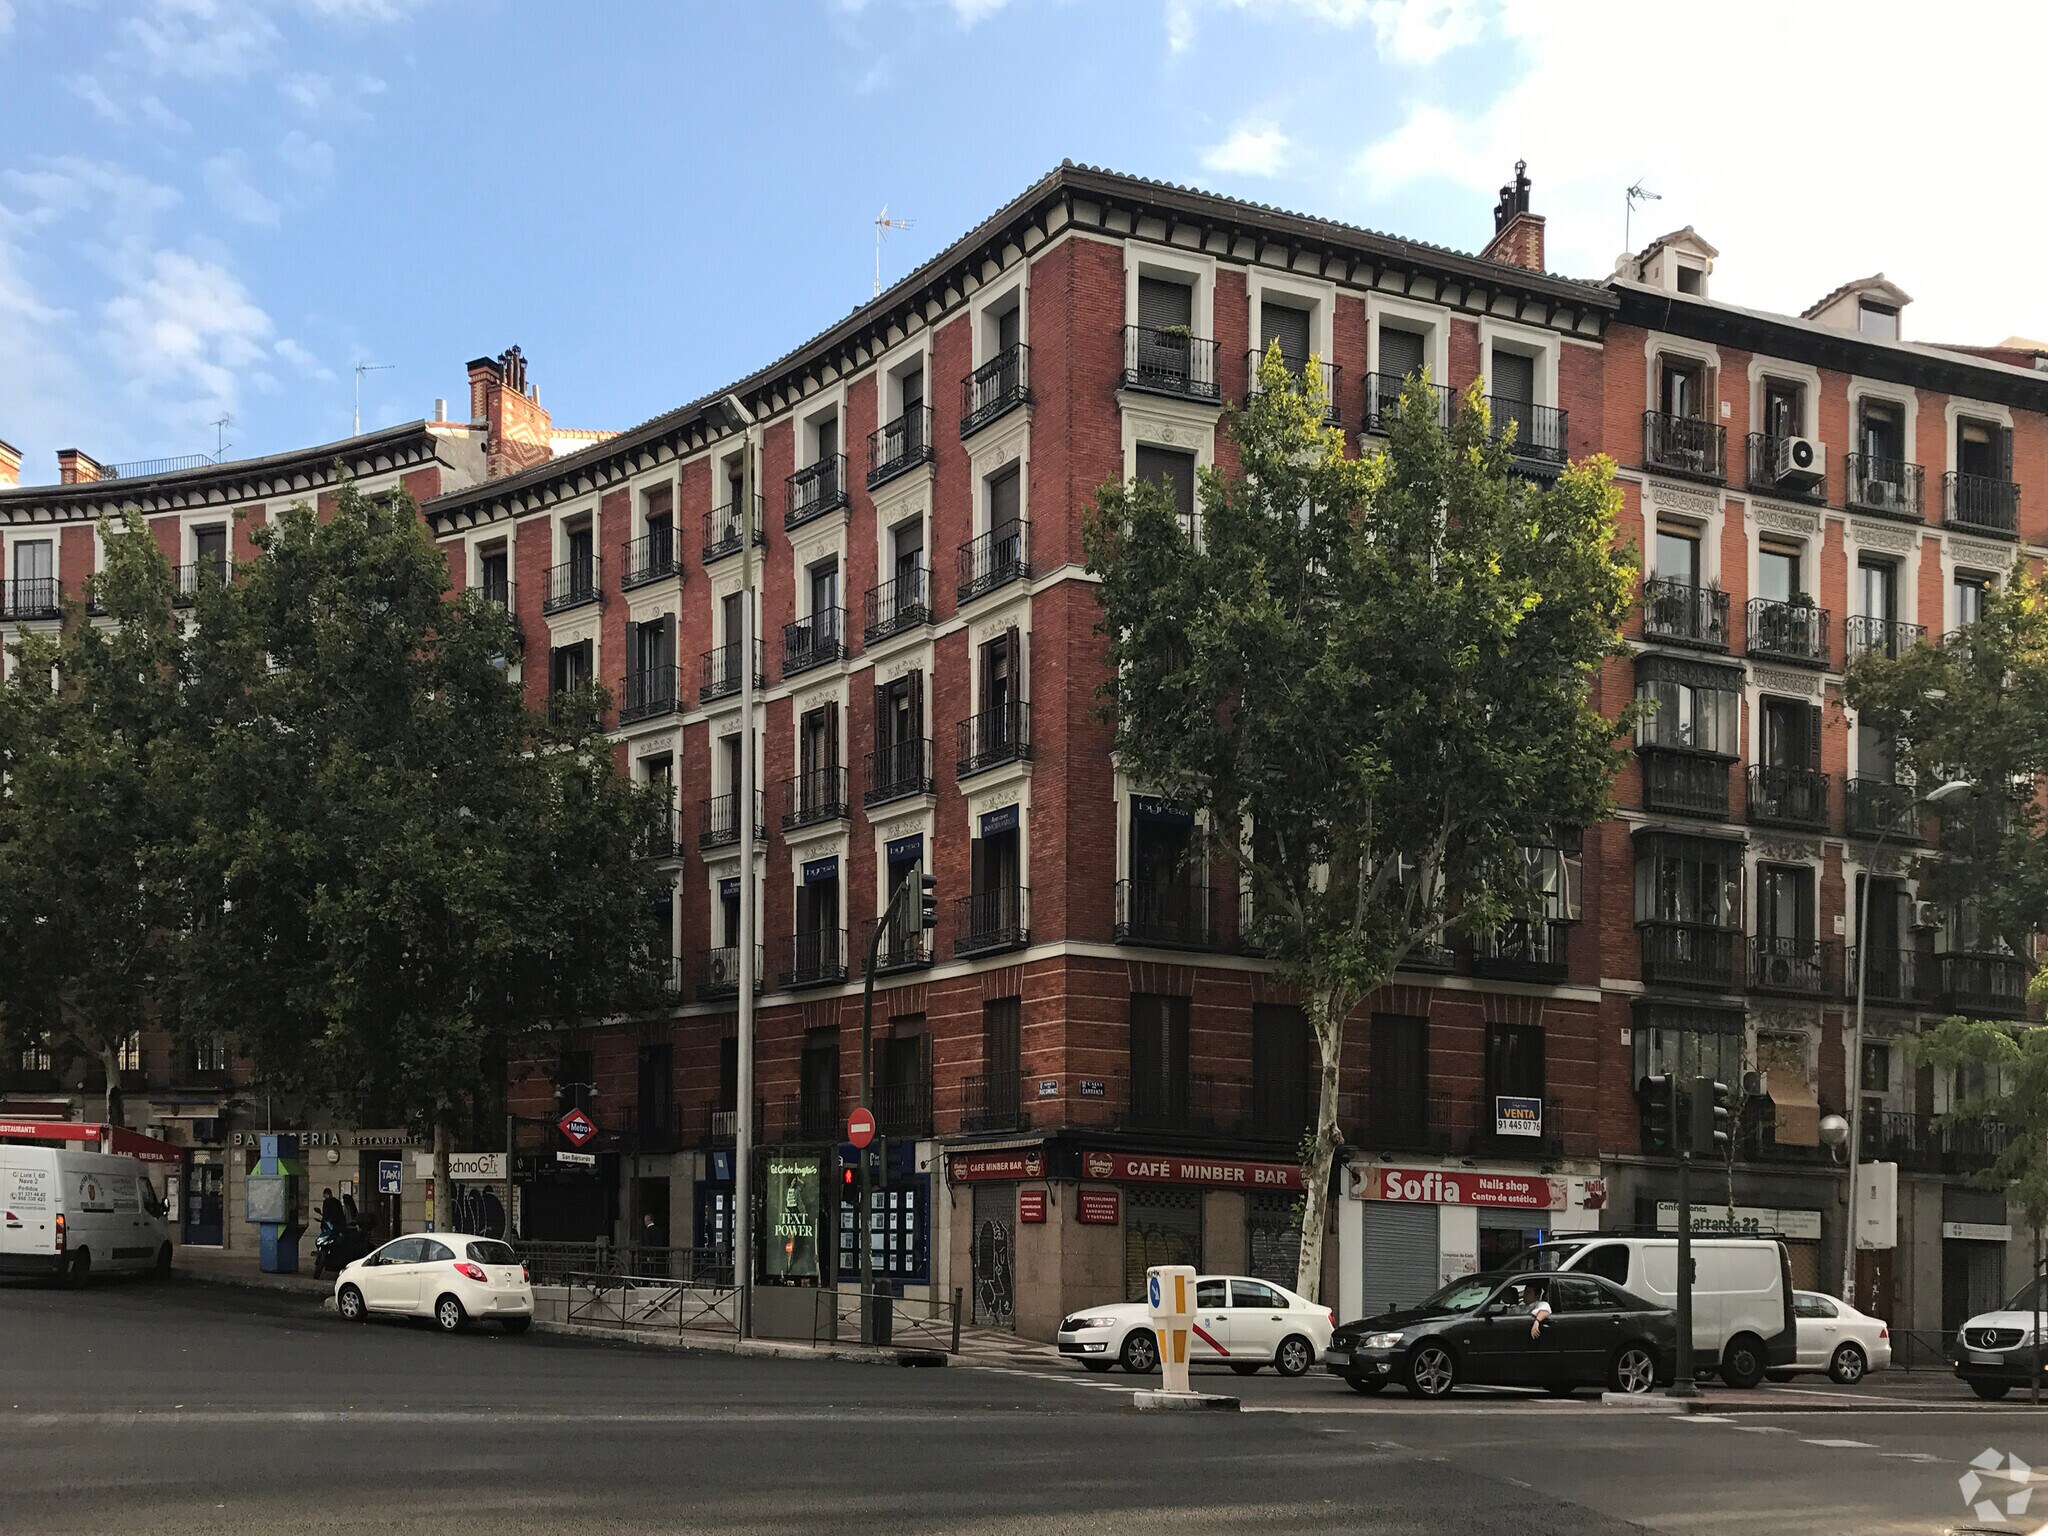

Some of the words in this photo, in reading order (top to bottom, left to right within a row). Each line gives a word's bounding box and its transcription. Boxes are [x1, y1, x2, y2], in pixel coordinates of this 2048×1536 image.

[1503, 1107, 1536, 1120] VENTA
[570, 1120, 590, 1134] Metro
[1497, 1119, 1507, 1129] 91
[1509, 1120, 1523, 1130] 445
[1523, 1120, 1532, 1131] 07
[1532, 1121, 1541, 1132] 76
[351, 1136, 421, 1145] RESTAURANTE
[139, 1152, 165, 1161] IBERIA
[561, 1153, 571, 1161] San
[777, 1164, 794, 1175] Corte
[793, 1161, 818, 1177] Inglés
[969, 1161, 985, 1173] CAFÉ
[986, 1161, 1009, 1172] MINBER
[1009, 1160, 1023, 1171] BAR
[1127, 1160, 1171, 1178] CAFÉ
[1180, 1164, 1245, 1182] MINBER
[1254, 1169, 1288, 1184] BAR
[381, 1169, 401, 1180] TAXI
[1386, 1171, 1461, 1203] Sofia
[1479, 1178, 1504, 1191] Nails
[1505, 1179, 1530, 1193] shop
[1584, 1179, 1605, 1193] Nails
[1471, 1191, 1497, 1202] Centro
[1497, 1192, 1508, 1203] de
[1508, 1192, 1538, 1204] estética
[779, 1212, 809, 1225] TEXT
[1742, 1216, 1760, 1233] 22
[774, 1224, 813, 1237] POWER
